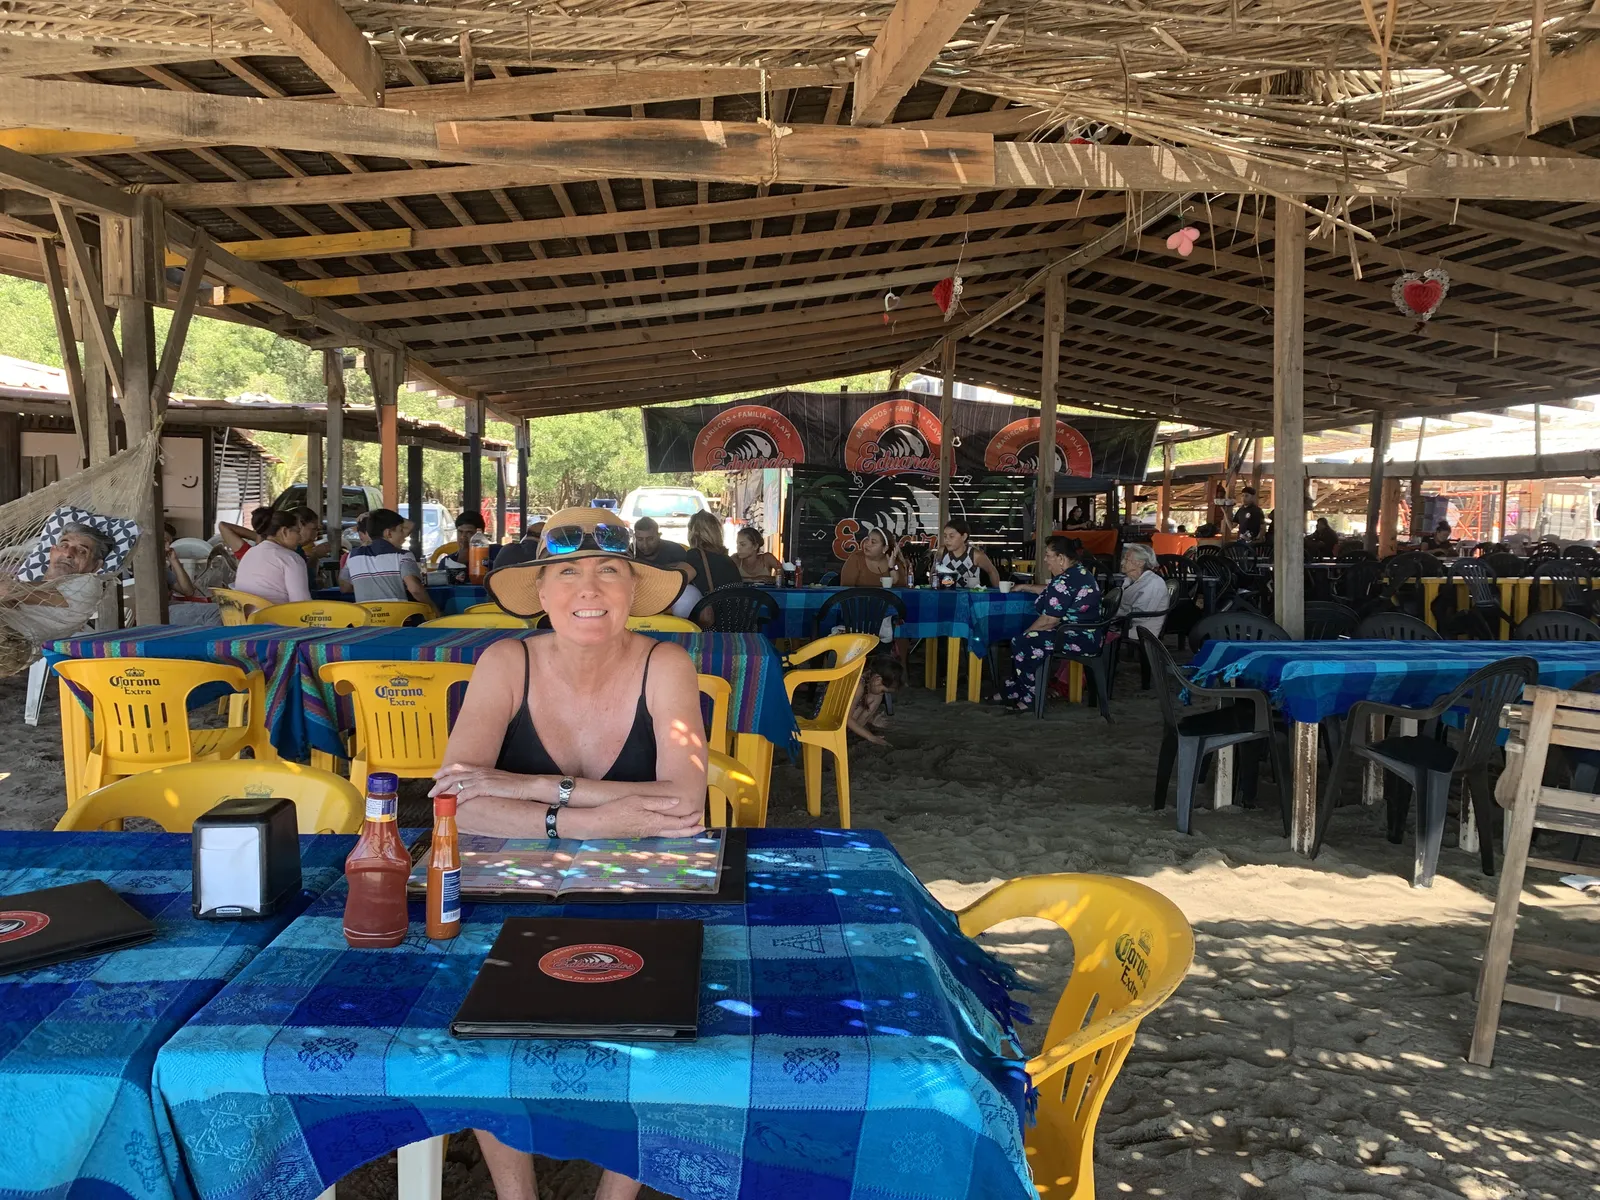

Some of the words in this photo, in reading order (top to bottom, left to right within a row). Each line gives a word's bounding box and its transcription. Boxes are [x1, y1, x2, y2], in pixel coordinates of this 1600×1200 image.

[702, 416, 732, 446] MARISCOS
[738, 411, 767, 419] FAMILIA
[772, 418, 792, 440] PLAYA
[856, 408, 888, 439] MARISCOS
[895, 405, 921, 419] FAMILIA
[996, 425, 1029, 449] MARISCOS
[1070, 437, 1084, 457] PLAYA
[855, 441, 942, 474] Eduardo
[109, 675, 161, 689] Corona
[124, 687, 151, 695] Extra
[375, 685, 424, 700] Corona
[389, 698, 416, 706] Extra
[1115, 934, 1150, 989] Corona
[1121, 965, 1138, 1000] Extra
